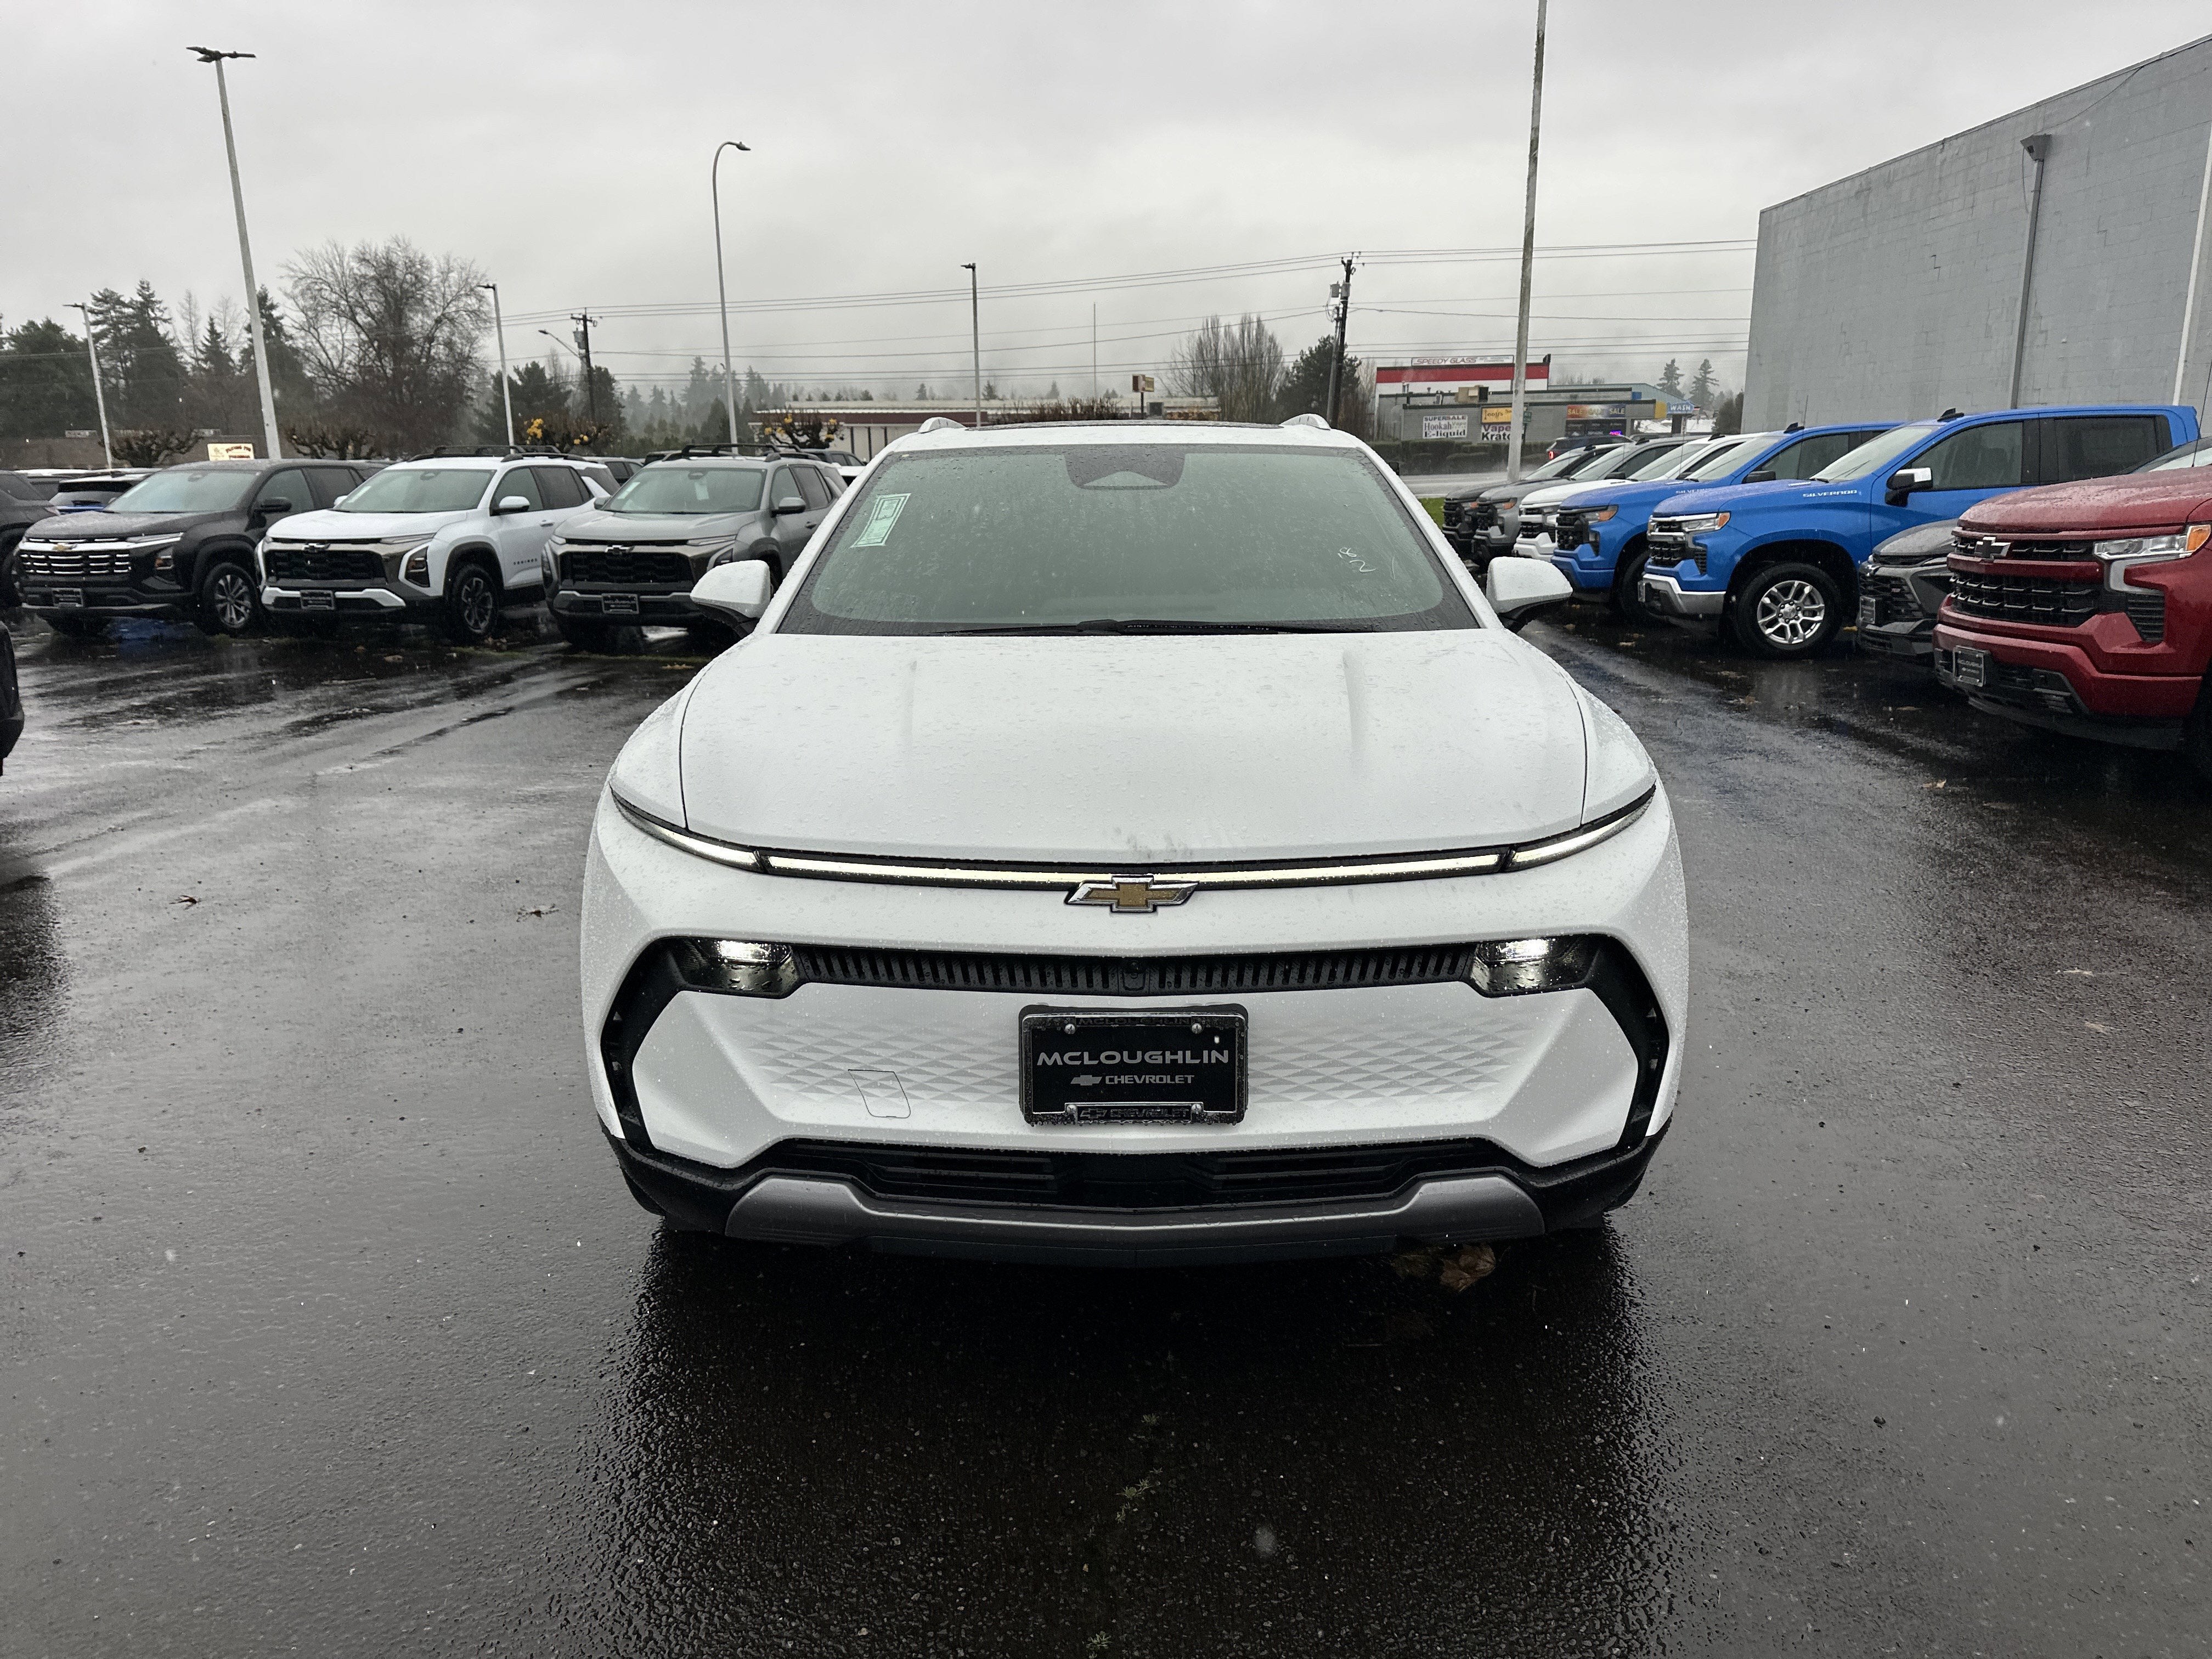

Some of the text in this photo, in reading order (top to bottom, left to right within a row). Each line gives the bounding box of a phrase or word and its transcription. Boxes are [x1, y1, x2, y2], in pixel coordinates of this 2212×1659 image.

[1424, 421, 1452, 430] Hookah
[1483, 424, 1511, 432] Vape
[1803, 489, 1858, 498] SILVERADO
[1037, 1050, 1229, 1066] MCLOUGHLIN
[1105, 1075, 1195, 1085] CHEVROLET
[1109, 1108, 1189, 1118] CHEVROLET
